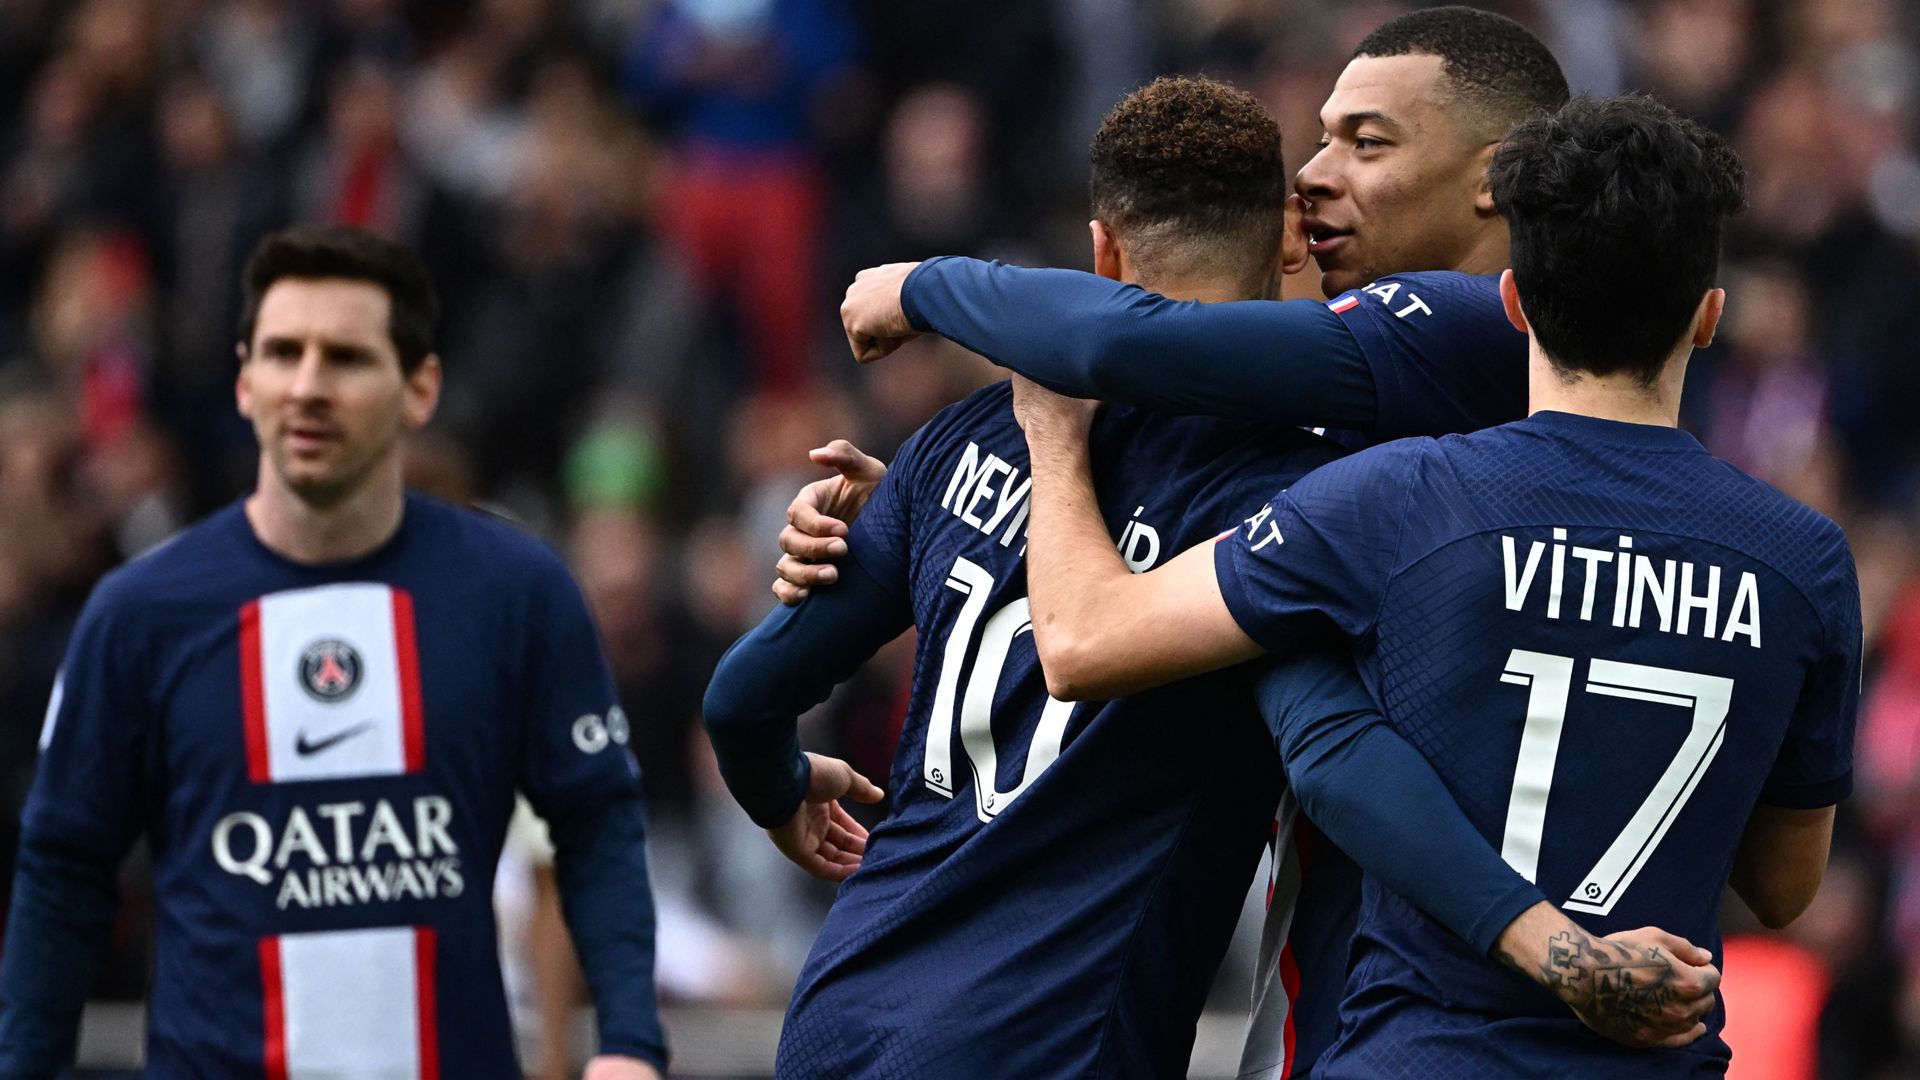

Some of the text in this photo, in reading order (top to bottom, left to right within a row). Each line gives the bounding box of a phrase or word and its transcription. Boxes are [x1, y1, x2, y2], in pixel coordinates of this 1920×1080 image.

[1243, 502, 1285, 552] AT
[1501, 527, 1761, 649] VITINHA
[924, 555, 1077, 824] 10
[1500, 648, 1735, 917] 17
[212, 796, 458, 885] QATAR
[275, 859, 465, 910] AIRWAYS
